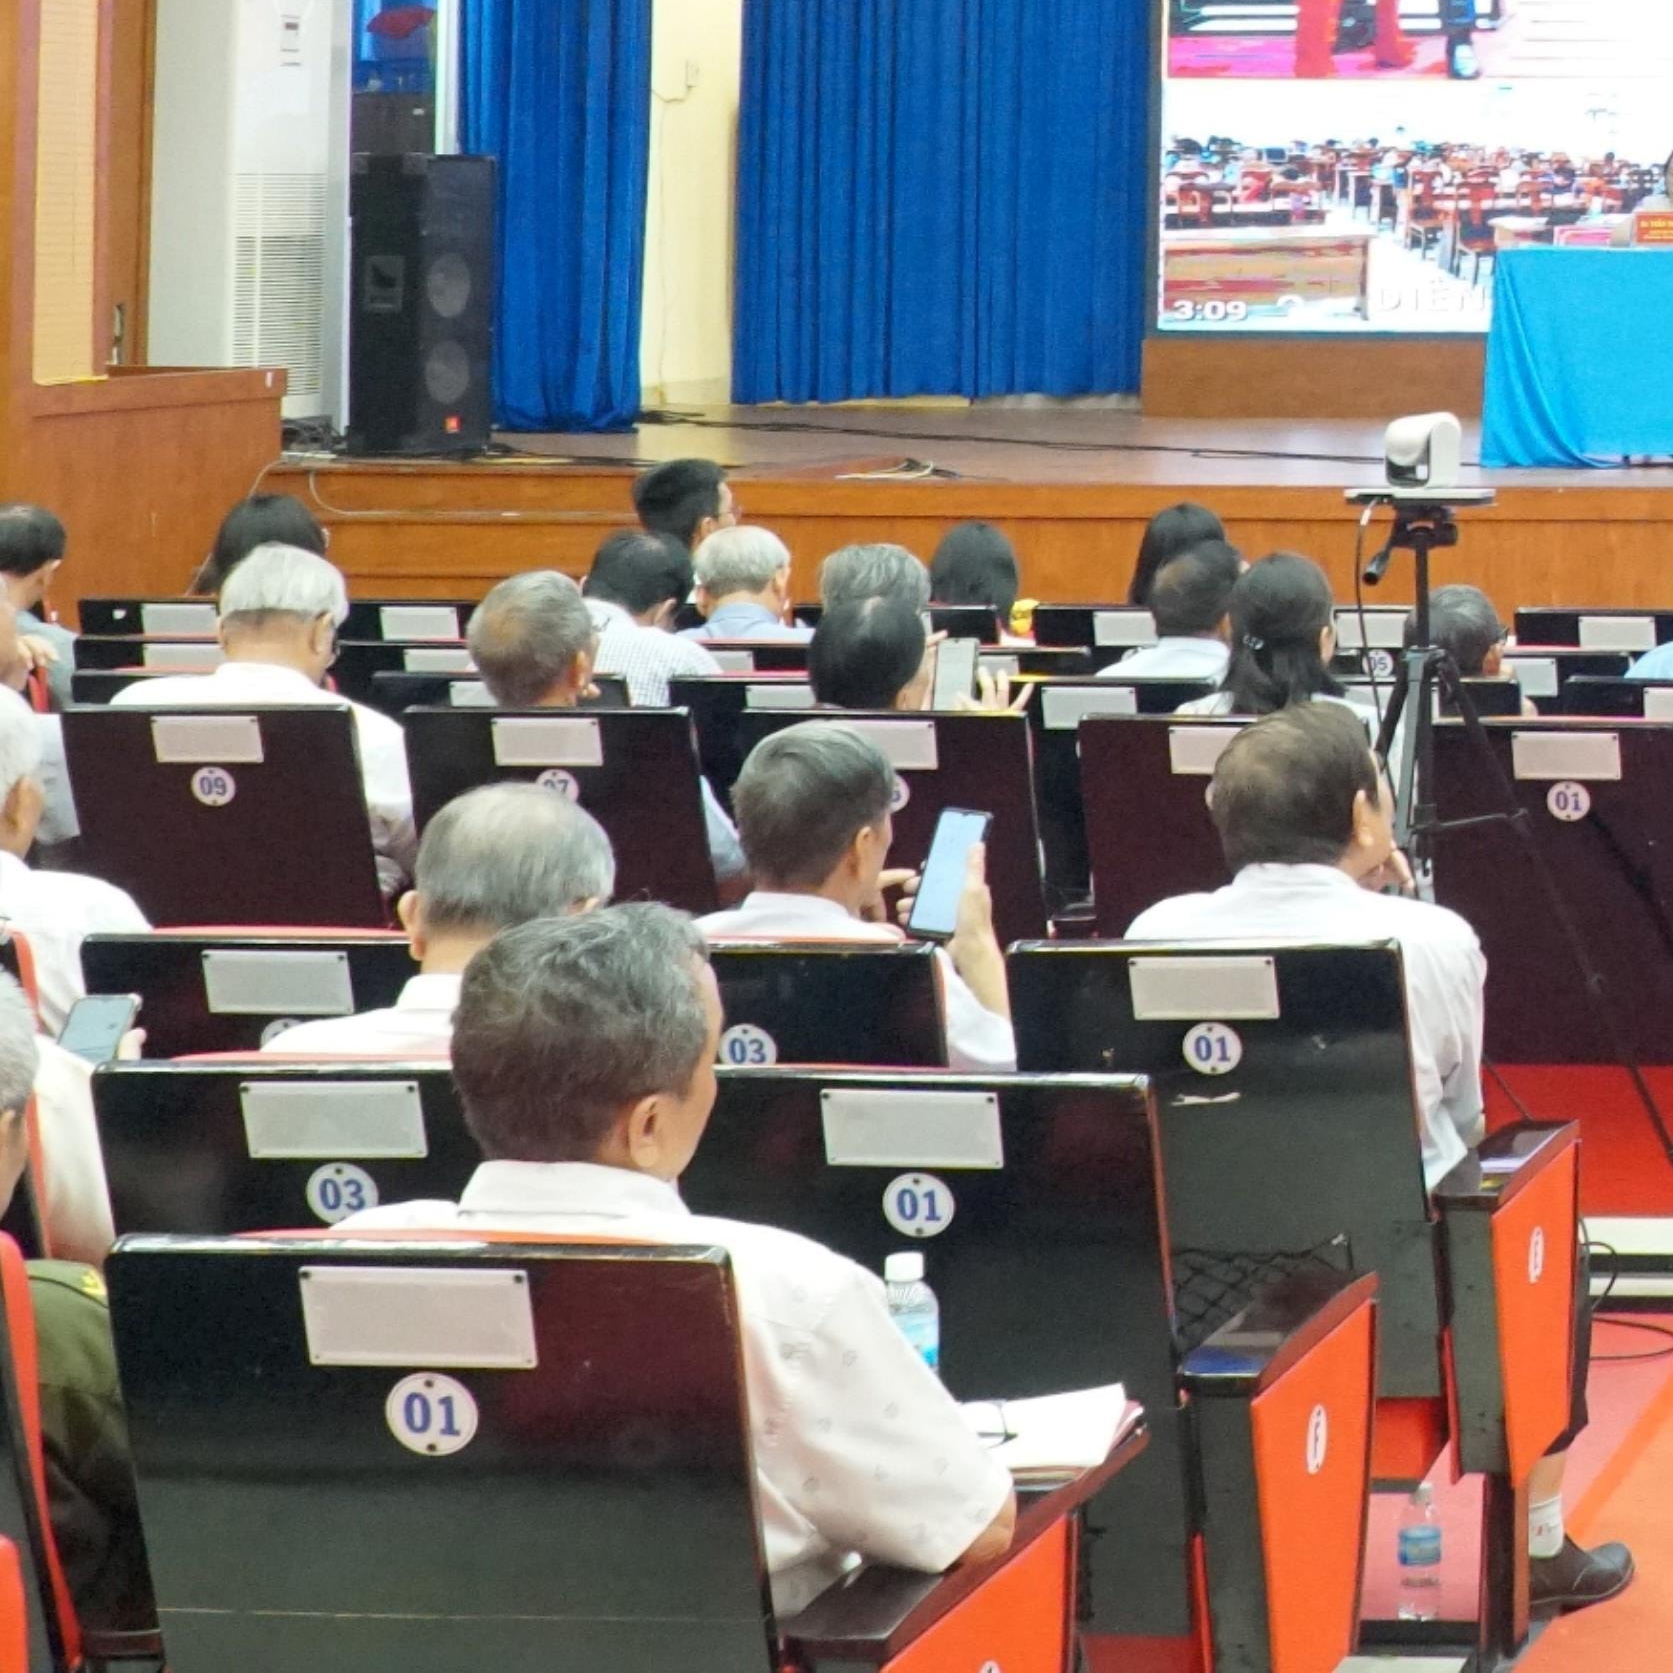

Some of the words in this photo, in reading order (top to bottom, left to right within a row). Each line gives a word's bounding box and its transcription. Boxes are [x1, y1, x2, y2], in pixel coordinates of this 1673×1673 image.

[199, 775, 228, 797] 09
[1555, 789, 1583, 813] 01
[728, 1037, 768, 1065] 03
[1192, 1033, 1232, 1064] 01
[317, 1177, 367, 1213] 03
[896, 1187, 942, 1223] 01
[403, 1389, 462, 1437] 01
